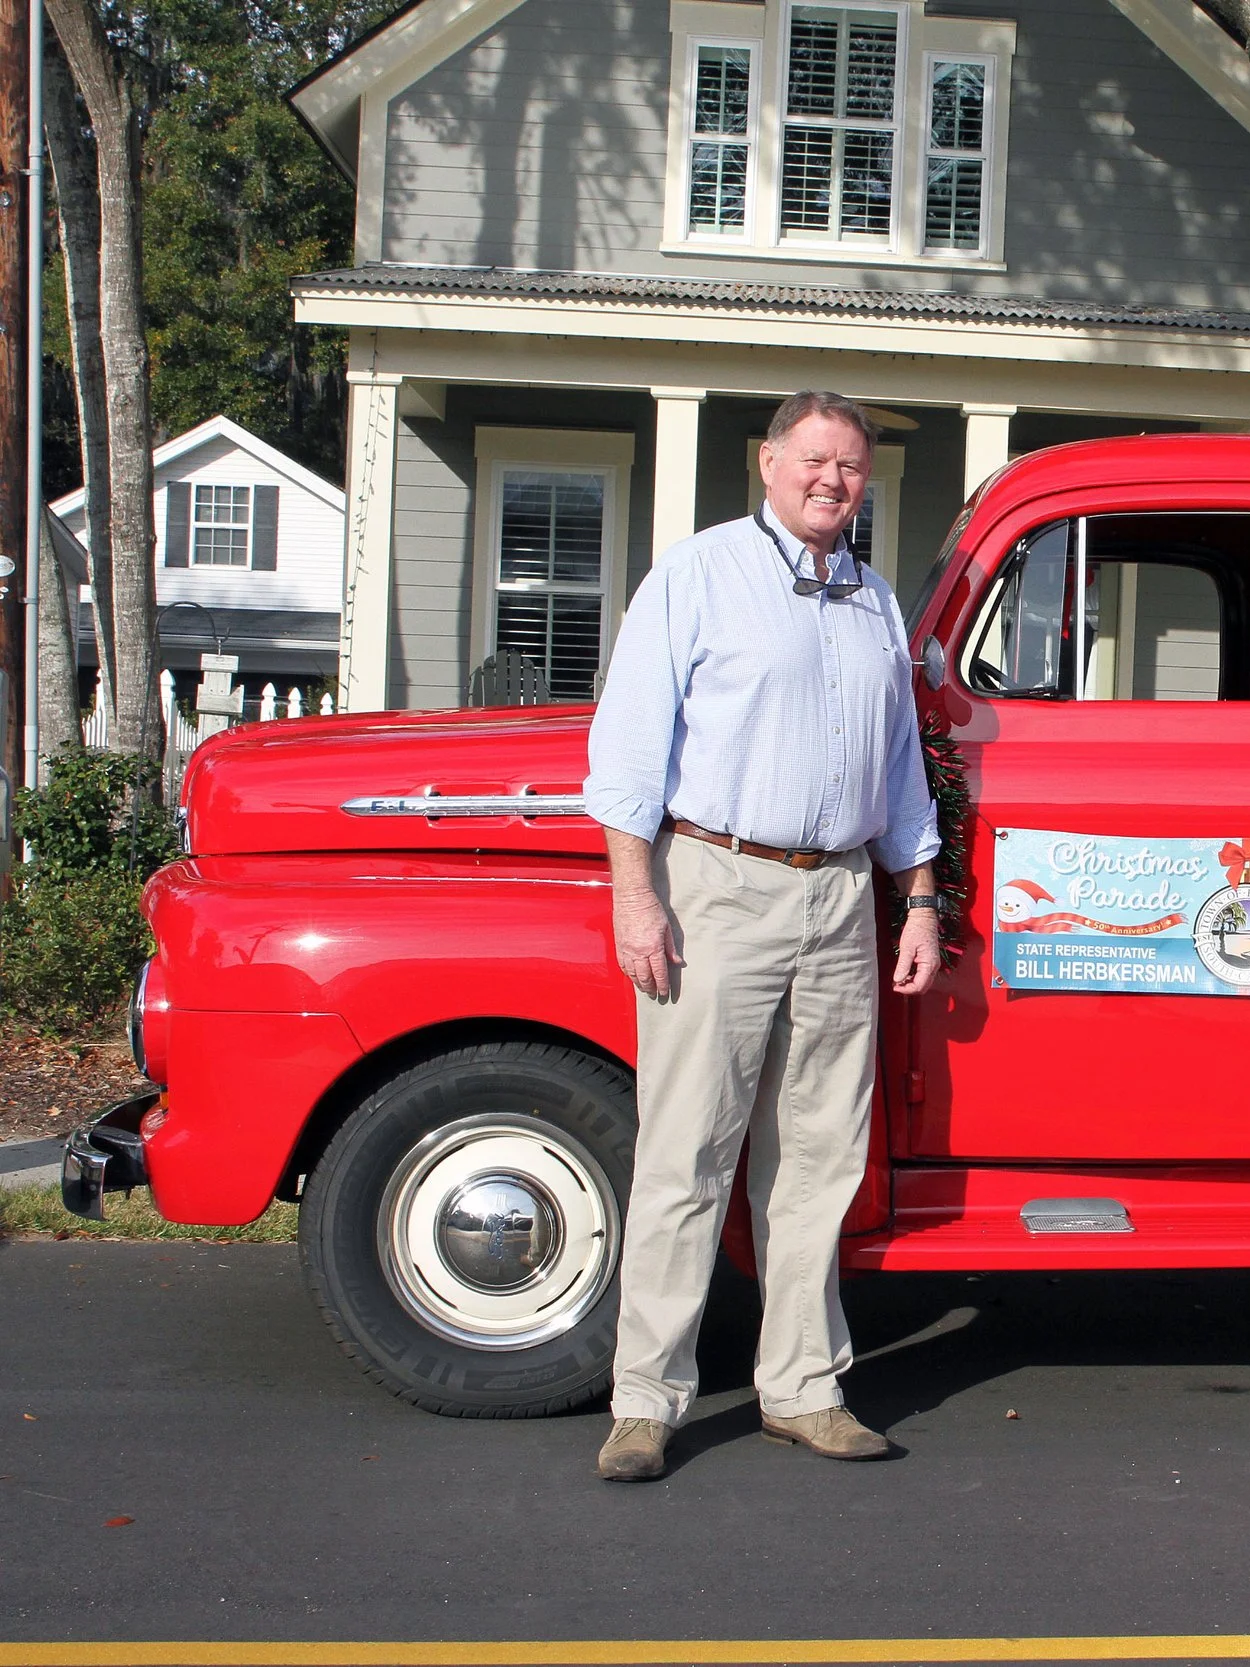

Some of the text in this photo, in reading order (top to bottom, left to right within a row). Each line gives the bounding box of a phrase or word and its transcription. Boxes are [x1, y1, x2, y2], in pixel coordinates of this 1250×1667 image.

[1048, 839, 1208, 881] Christmas
[1067, 876, 1188, 911] Parade
[1201, 900, 1224, 928] TOWN
[1093, 921, 1164, 934] 50th Anniversary!
[1016, 943, 1156, 960] STATE REPRESENTATIVE
[1015, 959, 1196, 983] BILL HERBKERSMAN
